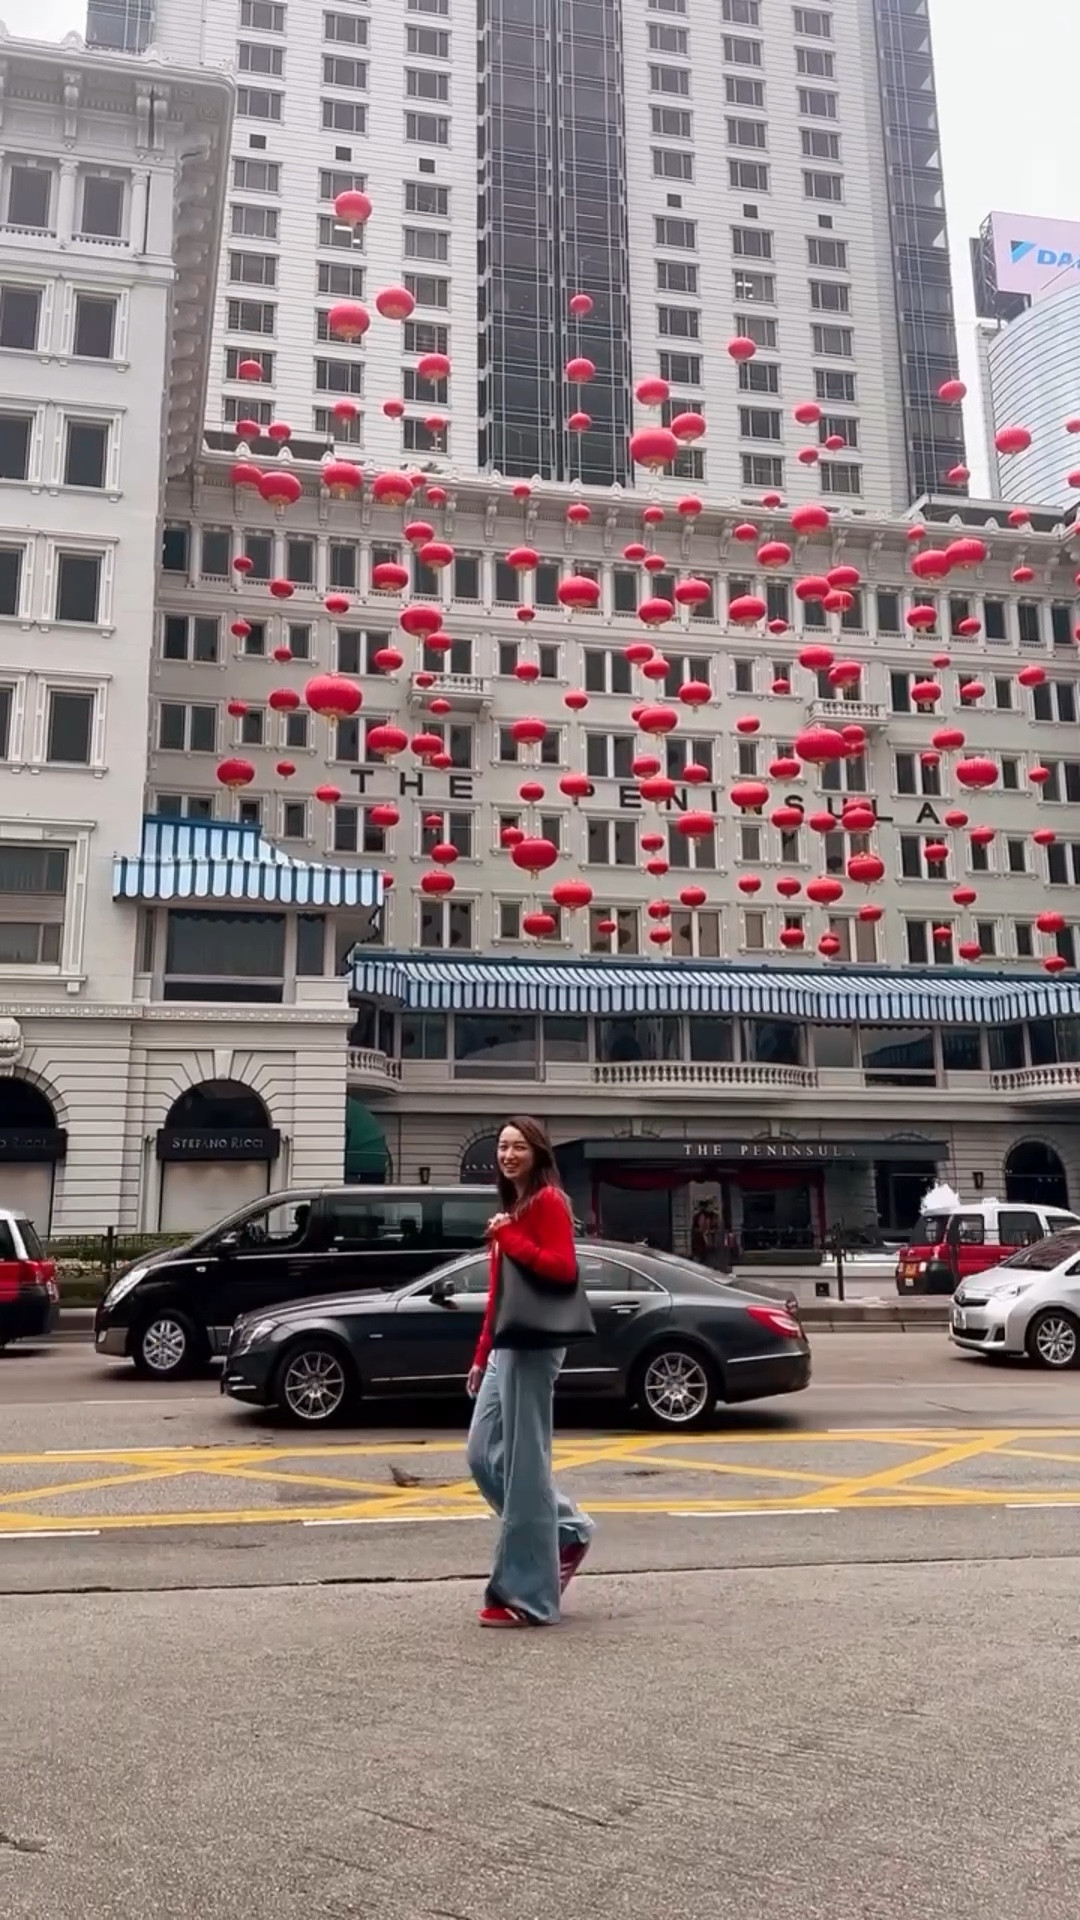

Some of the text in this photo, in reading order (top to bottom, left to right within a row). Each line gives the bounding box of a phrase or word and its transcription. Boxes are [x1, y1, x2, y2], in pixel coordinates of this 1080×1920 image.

[1037, 250, 1080, 268] DA
[350, 769, 941, 824] THE ENISULA
[172, 1137, 264, 1149] STEFANO RICCI
[683, 1144, 722, 1156] THE
